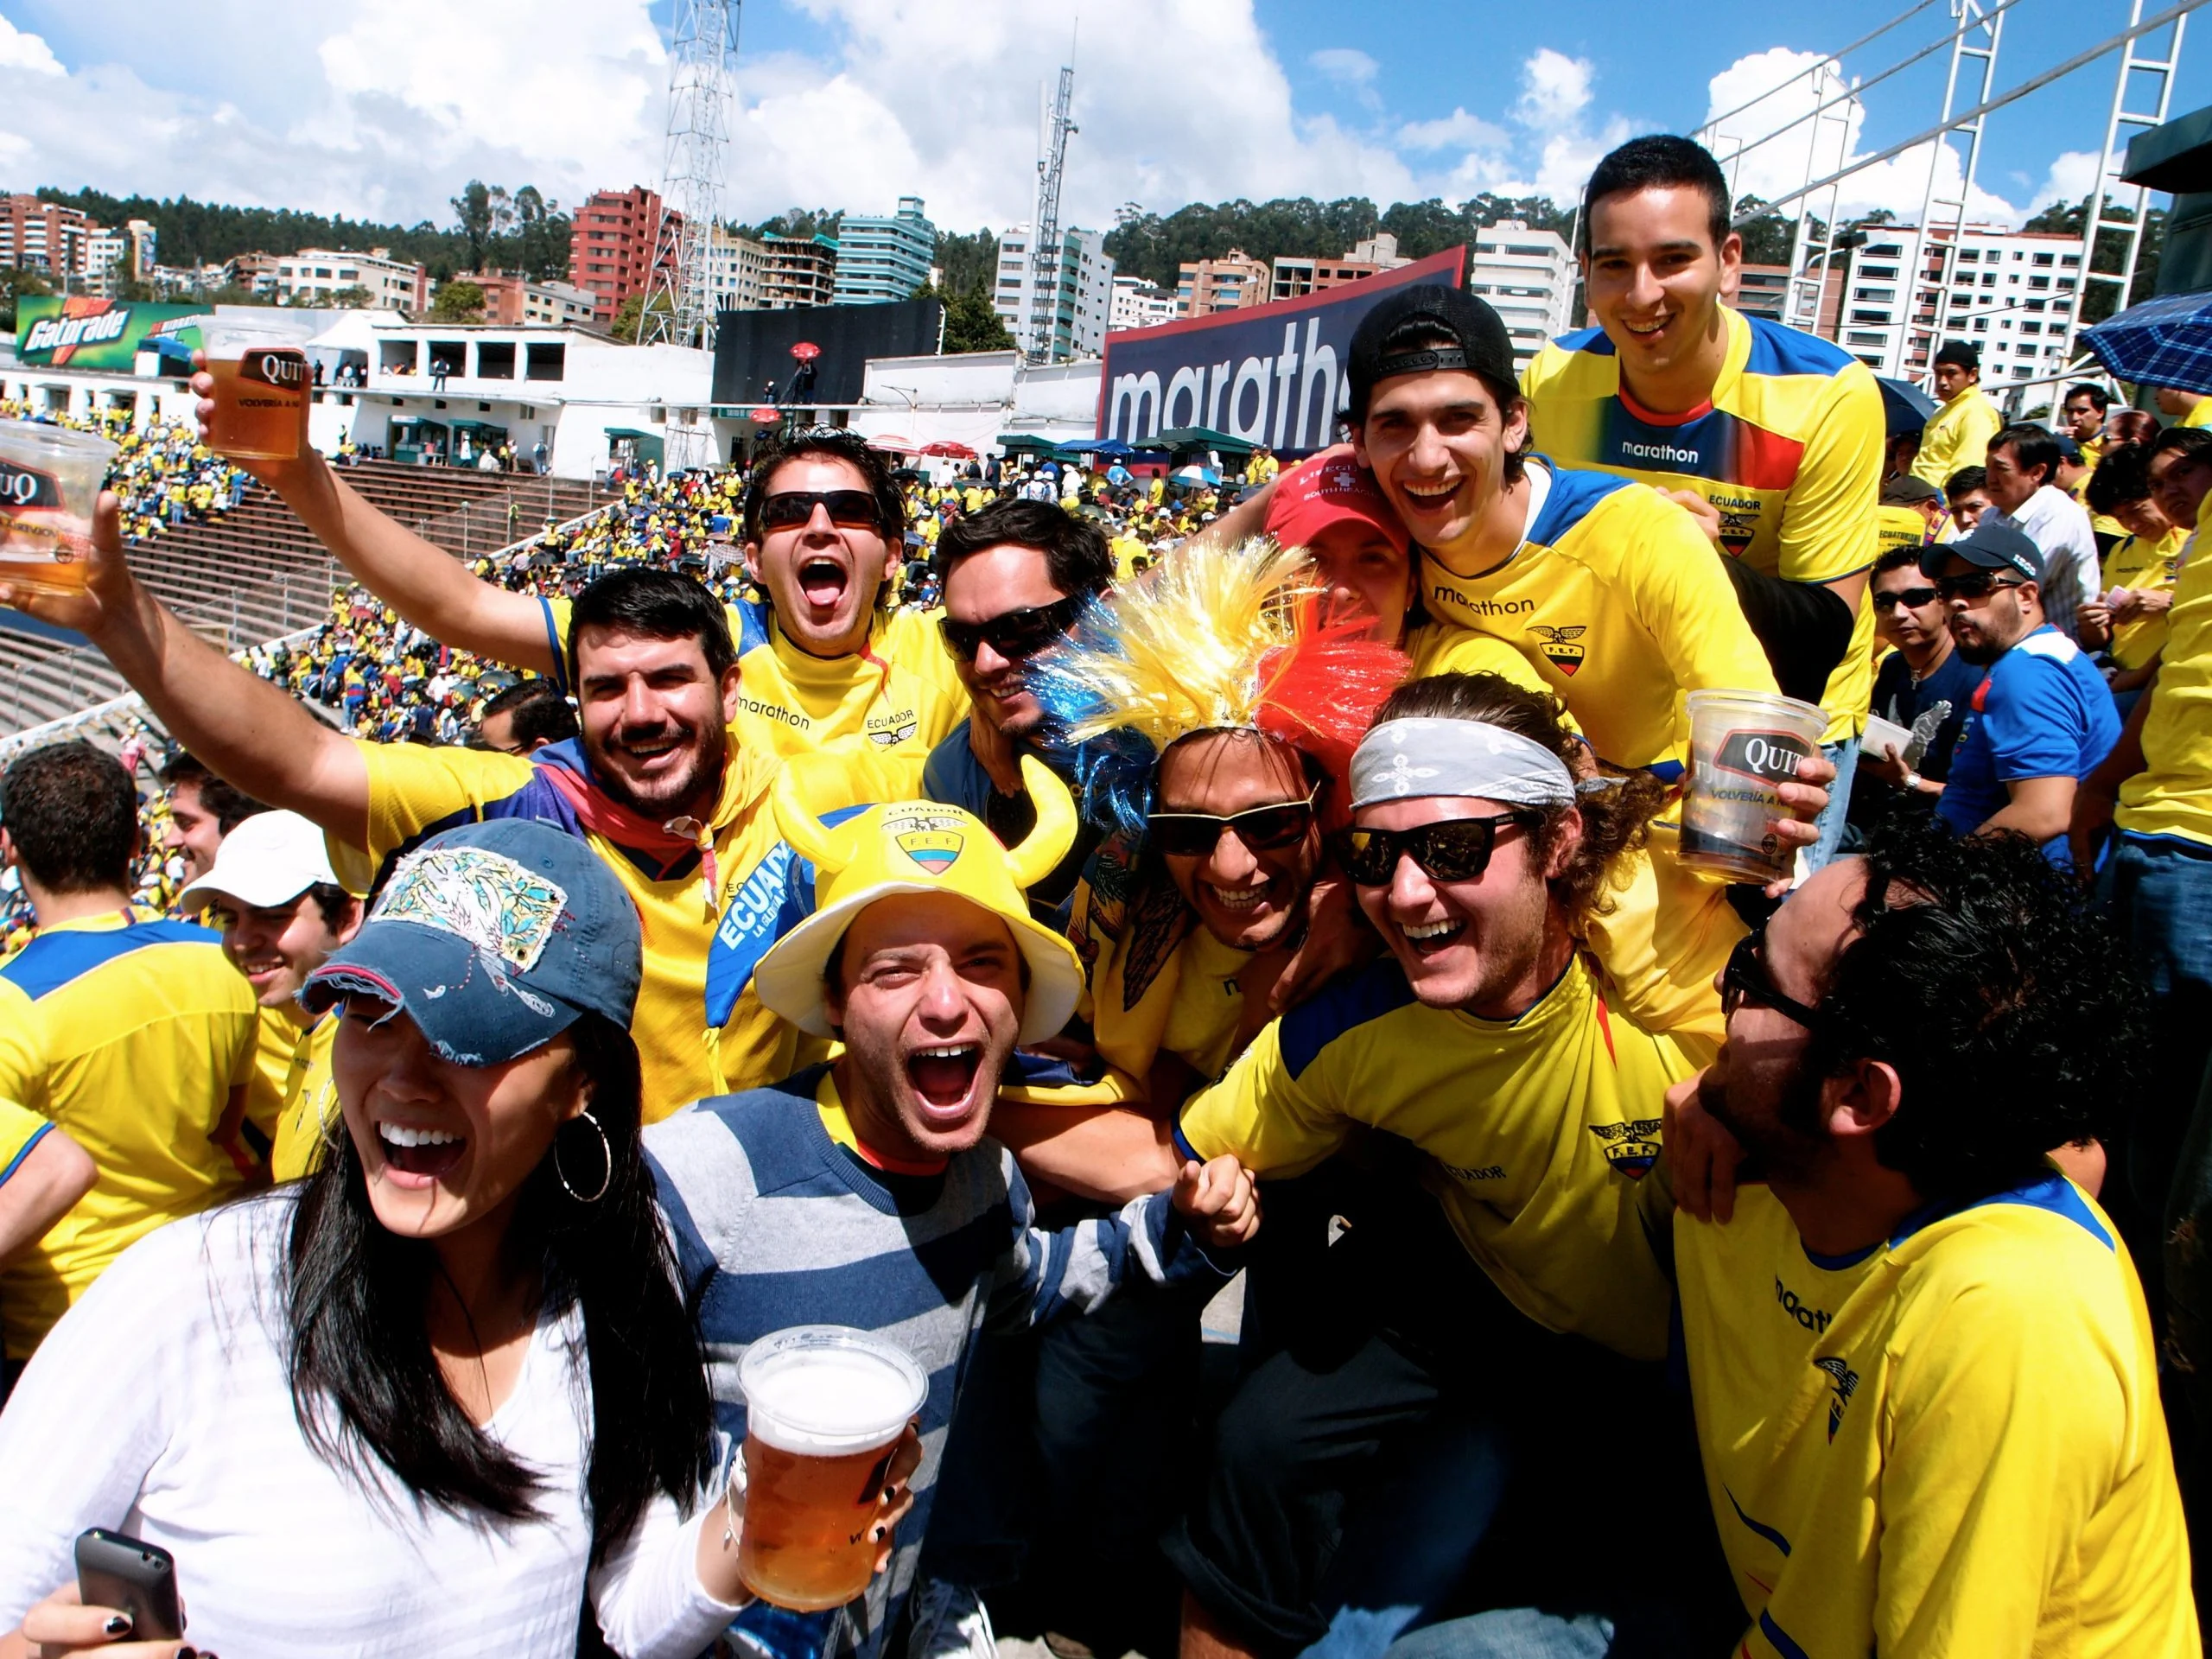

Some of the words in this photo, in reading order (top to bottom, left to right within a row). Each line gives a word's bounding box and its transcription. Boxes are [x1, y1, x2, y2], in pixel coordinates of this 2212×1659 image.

[24, 308, 130, 352] Gatorade
[1109, 316, 1351, 450] marath
[1622, 441, 1700, 464] marathon
[1708, 494, 1761, 511] ECUADOR
[1433, 586, 1535, 617] maathon
[867, 709, 915, 729] ECUADOR
[1712, 789, 1764, 804] VOLVERÍA
[1767, 796, 1775, 804] A
